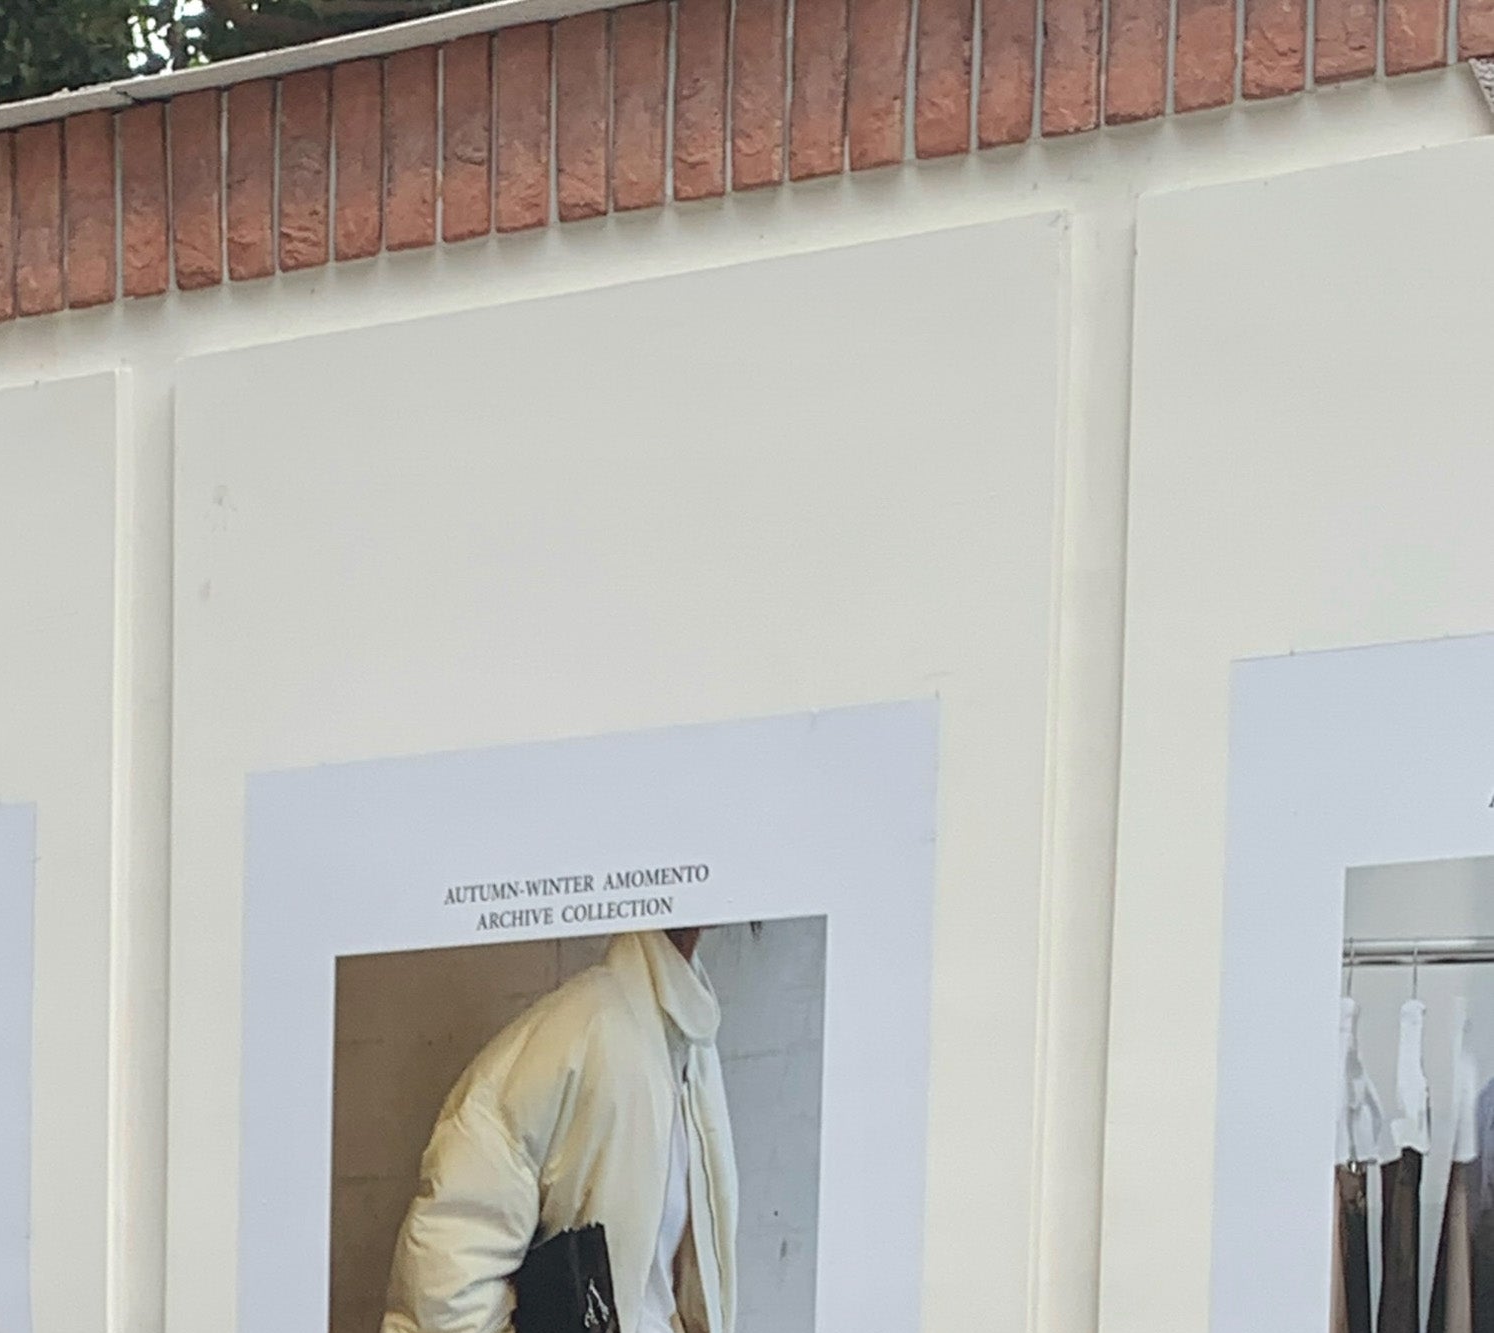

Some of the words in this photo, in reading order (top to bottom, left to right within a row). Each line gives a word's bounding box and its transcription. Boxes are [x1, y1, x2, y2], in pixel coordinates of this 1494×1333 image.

[443, 874, 595, 906] AUTUMN-WINTER
[602, 863, 710, 892] AMOMENTO
[475, 906, 555, 931] ARCHIVE
[561, 896, 674, 924] COLLECTION
